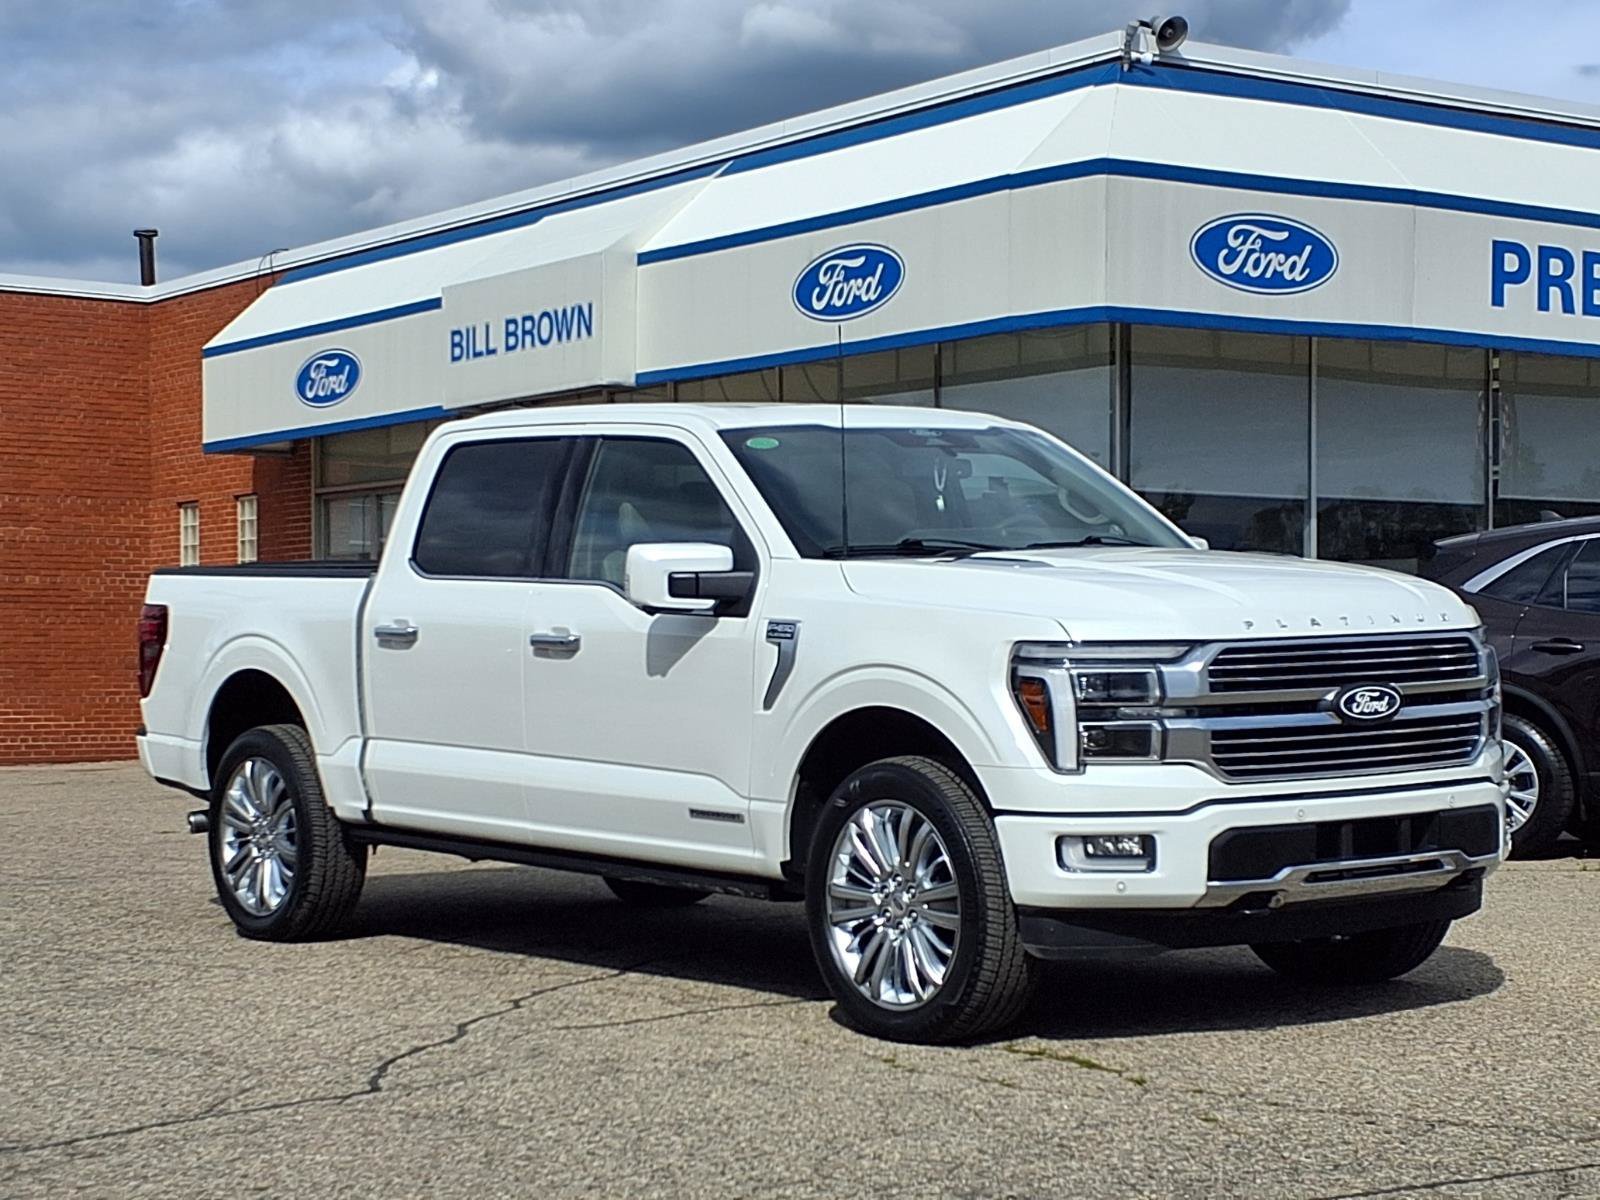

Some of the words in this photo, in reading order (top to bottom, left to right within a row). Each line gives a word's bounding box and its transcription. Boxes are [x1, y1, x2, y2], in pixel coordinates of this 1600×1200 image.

[1217, 224, 1313, 281] Ford
[1490, 239, 1600, 317] PRE
[811, 255, 884, 311] Ford
[450, 323, 498, 363] BILL
[504, 302, 593, 353] BROWN
[305, 358, 350, 399] Ford
[1352, 691, 1390, 713] Ford
